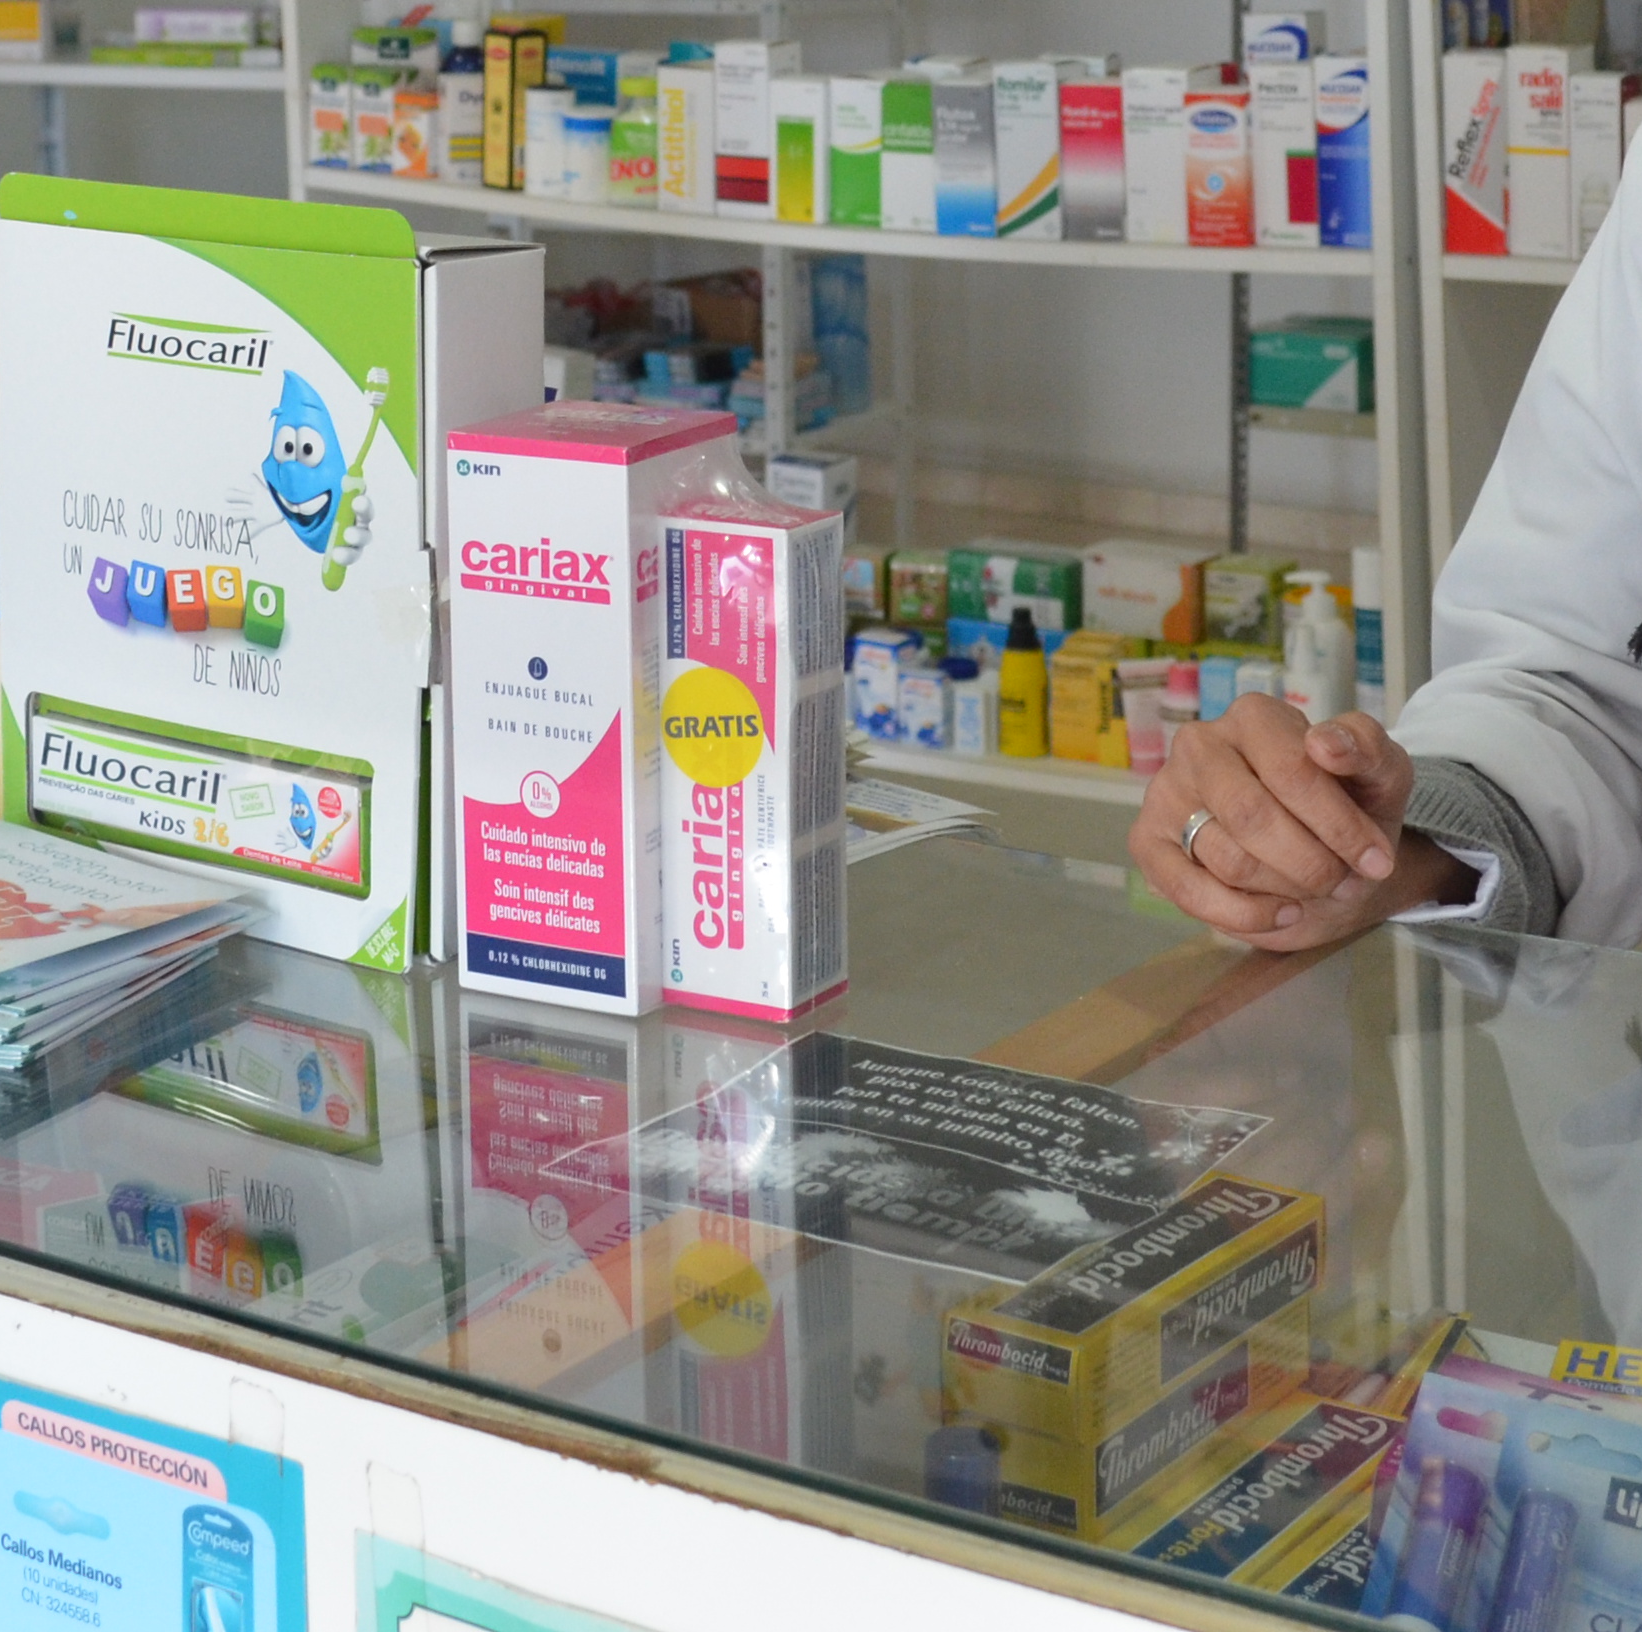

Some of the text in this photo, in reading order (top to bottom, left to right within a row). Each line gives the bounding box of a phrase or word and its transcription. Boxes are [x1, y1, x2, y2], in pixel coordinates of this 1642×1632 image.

[997, 77, 1047, 91] Romilar
[663, 87, 686, 199] Actithiol
[1448, 118, 1484, 179] Reflex
[106, 318, 271, 370] Fluocaril
[62, 487, 261, 564] CUIDAR SU SONRISA,
[62, 543, 278, 619] UN JUEGO
[459, 536, 612, 586] cariax
[483, 577, 589, 600] gingival
[191, 643, 283, 699] DE NIÑOS
[484, 682, 595, 709] ENJUAGUE BUCAL
[487, 718, 594, 745] BAIN DE BOUCHE
[664, 713, 760, 740] GRATIS
[38, 776, 136, 806] PREVENÇÃO DAS CÁRIES
[40, 731, 223, 805] Fluocaril
[243, 847, 303, 870] Dentes de Leite
[479, 821, 607, 856] Cuidado intensivo de
[483, 843, 605, 880] las encías delicadas
[489, 902, 601, 937] gencives délicates
[493, 877, 595, 912] Soin intensif des
[834, 1086, 1085, 1149] Pon tu mirada en El
[1067, 1184, 1281, 1301] Thrombocid
[1190, 1239, 1317, 1346] Thrombocid
[950, 1319, 1051, 1372] Thrombocid
[1564, 1375, 1639, 1396] Pomada
[16, 1408, 209, 1490] CALLOS PROTECCIÓN
[1098, 1378, 1221, 1497] Thrombocid
[1192, 1477, 1245, 1515] pomada
[0, 1532, 124, 1590] Callos Medianos
[188, 1520, 250, 1556] Compeed
